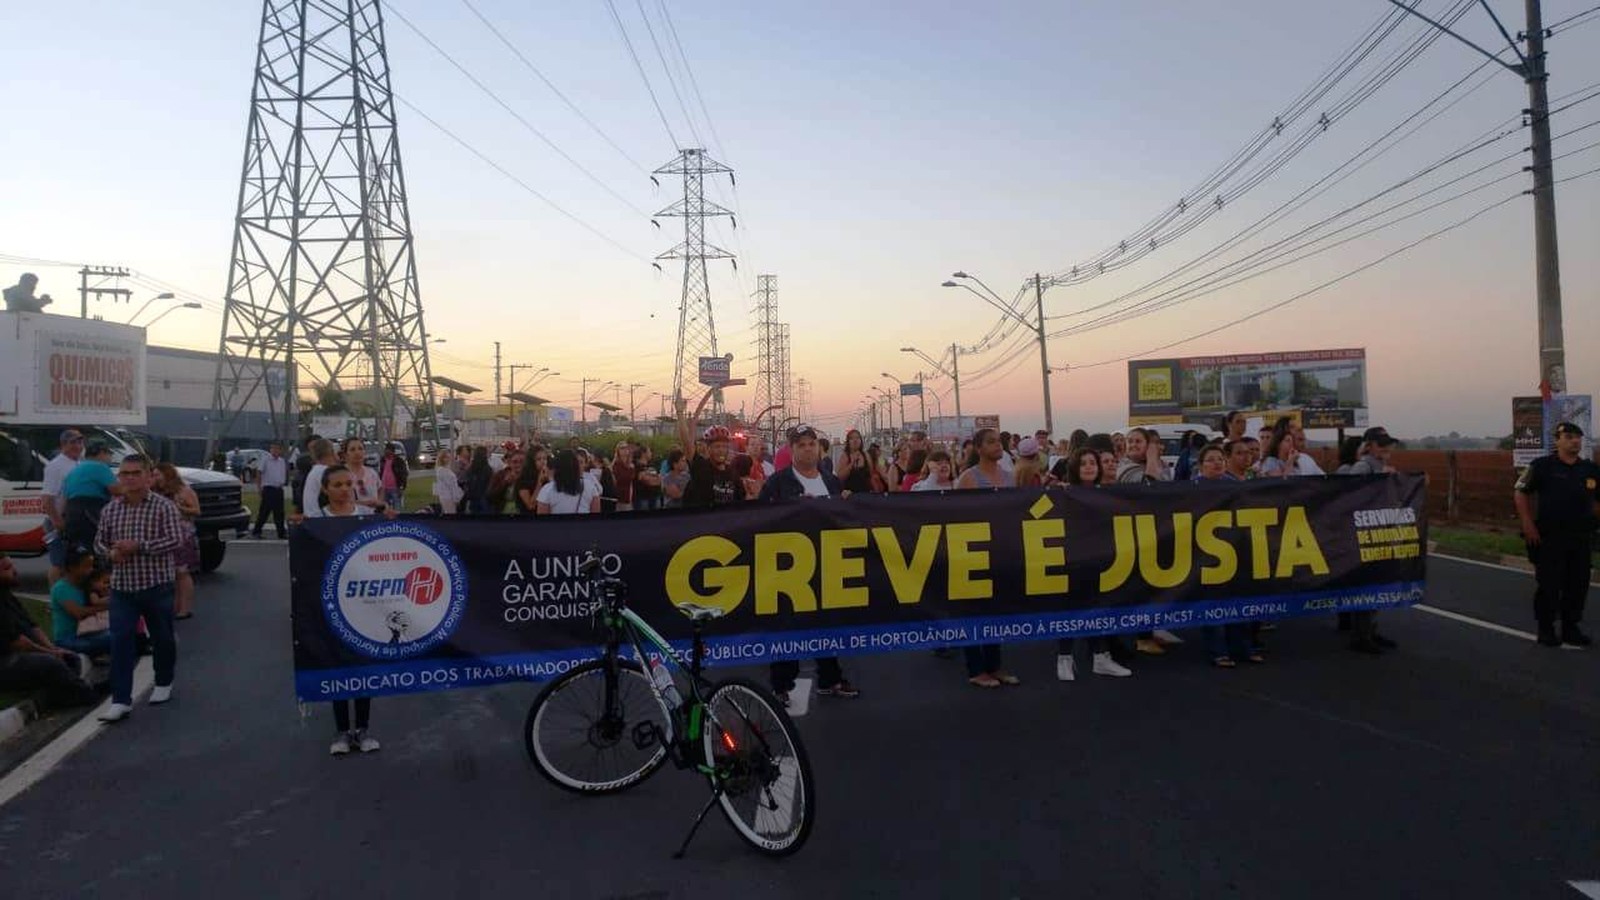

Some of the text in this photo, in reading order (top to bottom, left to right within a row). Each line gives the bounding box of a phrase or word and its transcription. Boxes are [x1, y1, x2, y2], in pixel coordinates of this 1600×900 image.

[359, 524, 438, 545] Trabalhadores
[368, 551, 418, 562] NOVO TEMPO
[664, 493, 1330, 617] GREVE É JUSTA
[504, 559, 525, 581] A
[320, 674, 415, 695] SINDICATO
[420, 667, 458, 684] DOS
[770, 638, 845, 655] MUNICIPAL
[850, 635, 866, 648] DE
[871, 627, 967, 647] HORTOLÂNDIA
[983, 623, 1033, 638] FILIADO
[1120, 614, 1151, 628] CSPB
[1154, 613, 1161, 624] E
[1163, 609, 1194, 622] NCST
[1205, 606, 1239, 620] NOVA
[1242, 602, 1289, 617] CENTRAL
